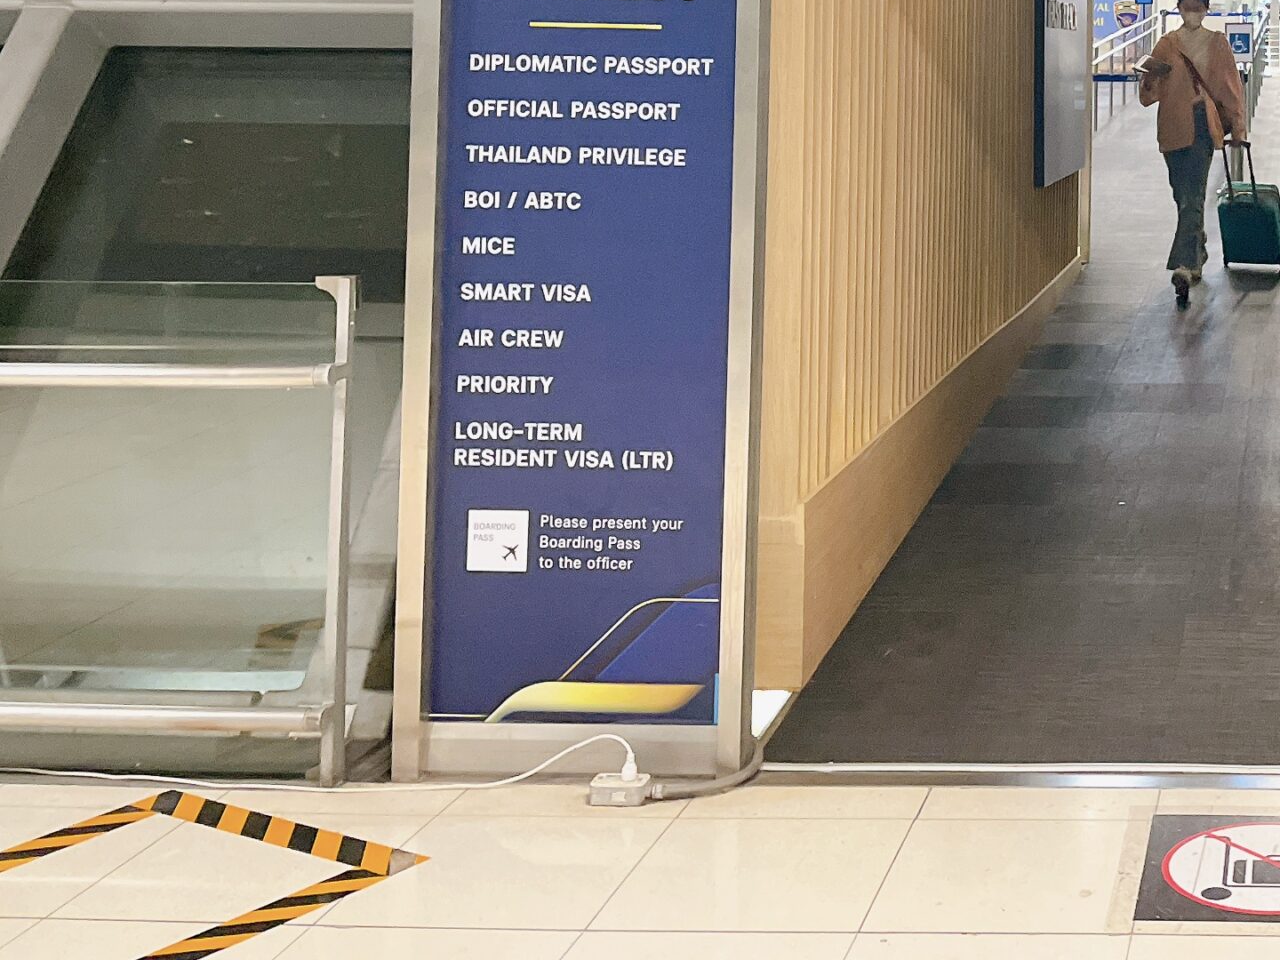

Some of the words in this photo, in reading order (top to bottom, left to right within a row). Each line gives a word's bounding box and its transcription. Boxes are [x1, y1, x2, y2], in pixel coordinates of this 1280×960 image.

[469, 54, 597, 74] DIPLOMATIC
[604, 57, 714, 76] PASSPORT
[467, 100, 564, 118] OFFICIAL
[570, 102, 681, 121] PASSPORT
[465, 145, 572, 164] THAILAND
[578, 147, 687, 167] PRIVILEGE
[463, 191, 501, 209] BOI
[507, 192, 518, 209] /
[523, 192, 582, 210] ABTC
[462, 237, 516, 255] MICE
[460, 283, 535, 302] SMART
[541, 284, 592, 302] VISA
[458, 329, 494, 347] AIR
[501, 330, 564, 348] CREW
[456, 375, 554, 394] PRIORITY
[455, 422, 583, 442] LONG-TERM
[454, 449, 558, 468] RESIDENT
[564, 450, 615, 469] VISA
[621, 451, 674, 471] (LTR)
[473, 523, 516, 531] BOARDING
[540, 515, 588, 529] Please
[592, 518, 647, 532] present
[651, 519, 684, 533] your
[473, 534, 494, 542] PASS
[539, 535, 603, 552] Boarding
[607, 536, 641, 550] Pass
[538, 557, 554, 569] to
[558, 557, 582, 570] the
[586, 557, 634, 571] officer
